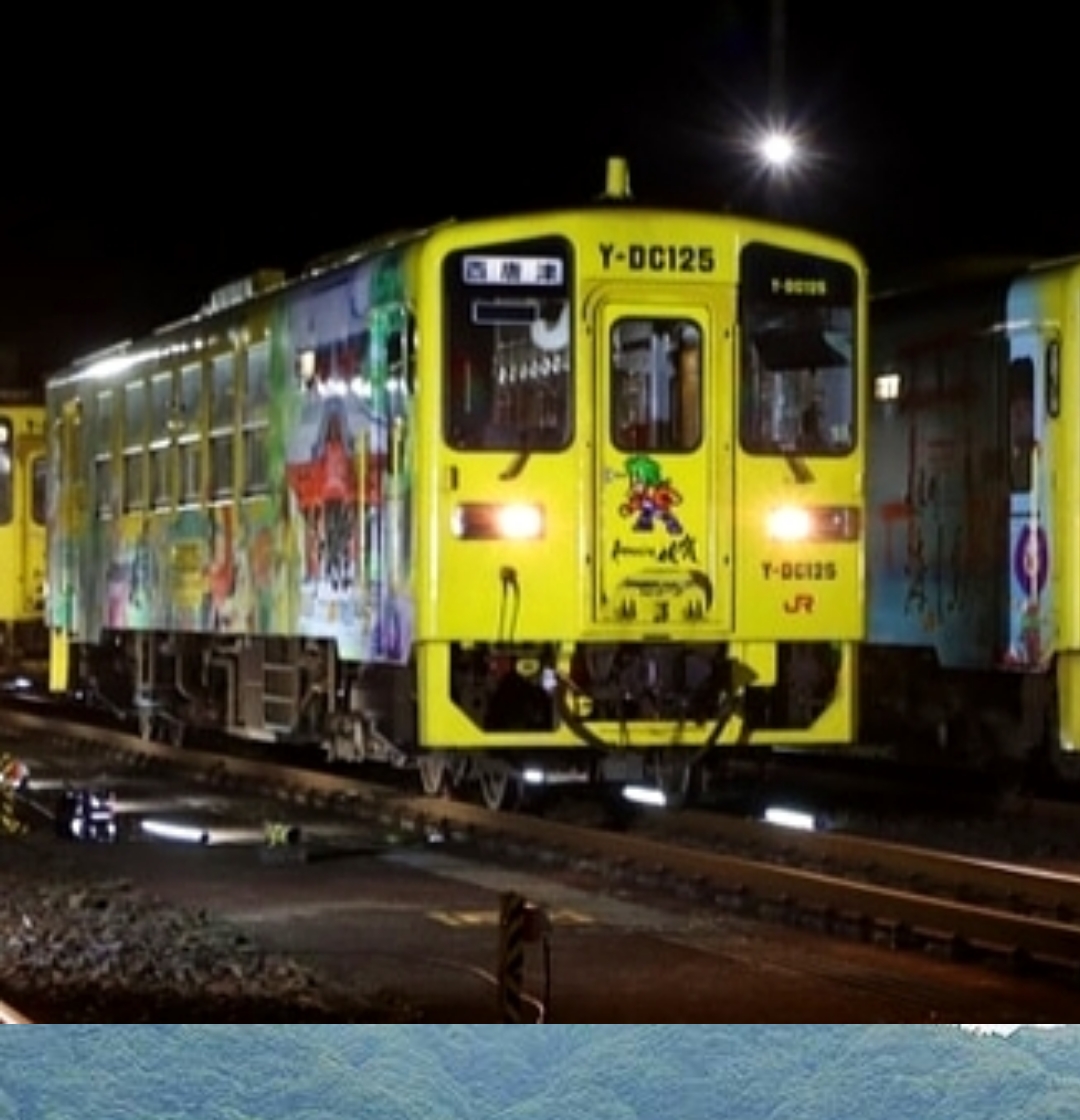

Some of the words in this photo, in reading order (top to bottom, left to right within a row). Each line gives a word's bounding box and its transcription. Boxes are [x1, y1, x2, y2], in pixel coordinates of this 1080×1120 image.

[599, 243, 715, 273] Y-DC125
[761, 563, 837, 581] Y-DC125
[784, 594, 814, 614] JR
